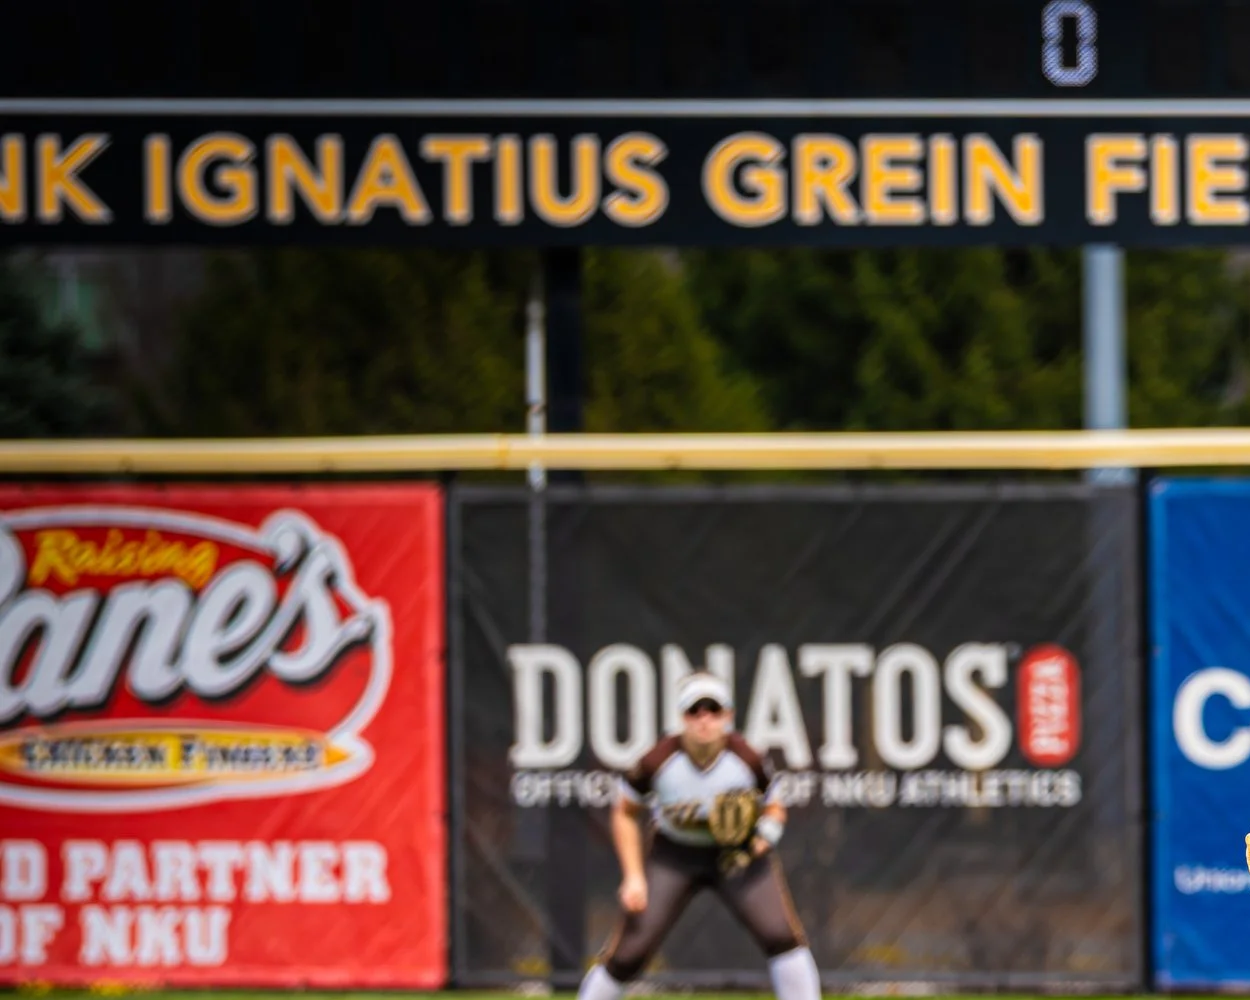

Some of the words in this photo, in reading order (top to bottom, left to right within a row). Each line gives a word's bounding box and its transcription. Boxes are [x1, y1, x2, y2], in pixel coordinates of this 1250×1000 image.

[144, 132, 671, 226] IGNATIUS
[702, 131, 1045, 227] GREIN
[29, 528, 220, 590] Raising
[0, 526, 374, 722] ane's
[822, 770, 897, 807] NKU
[898, 769, 1082, 808] ATHLETICS
[60, 839, 392, 903] PARTNER
[78, 904, 232, 968] NKU
